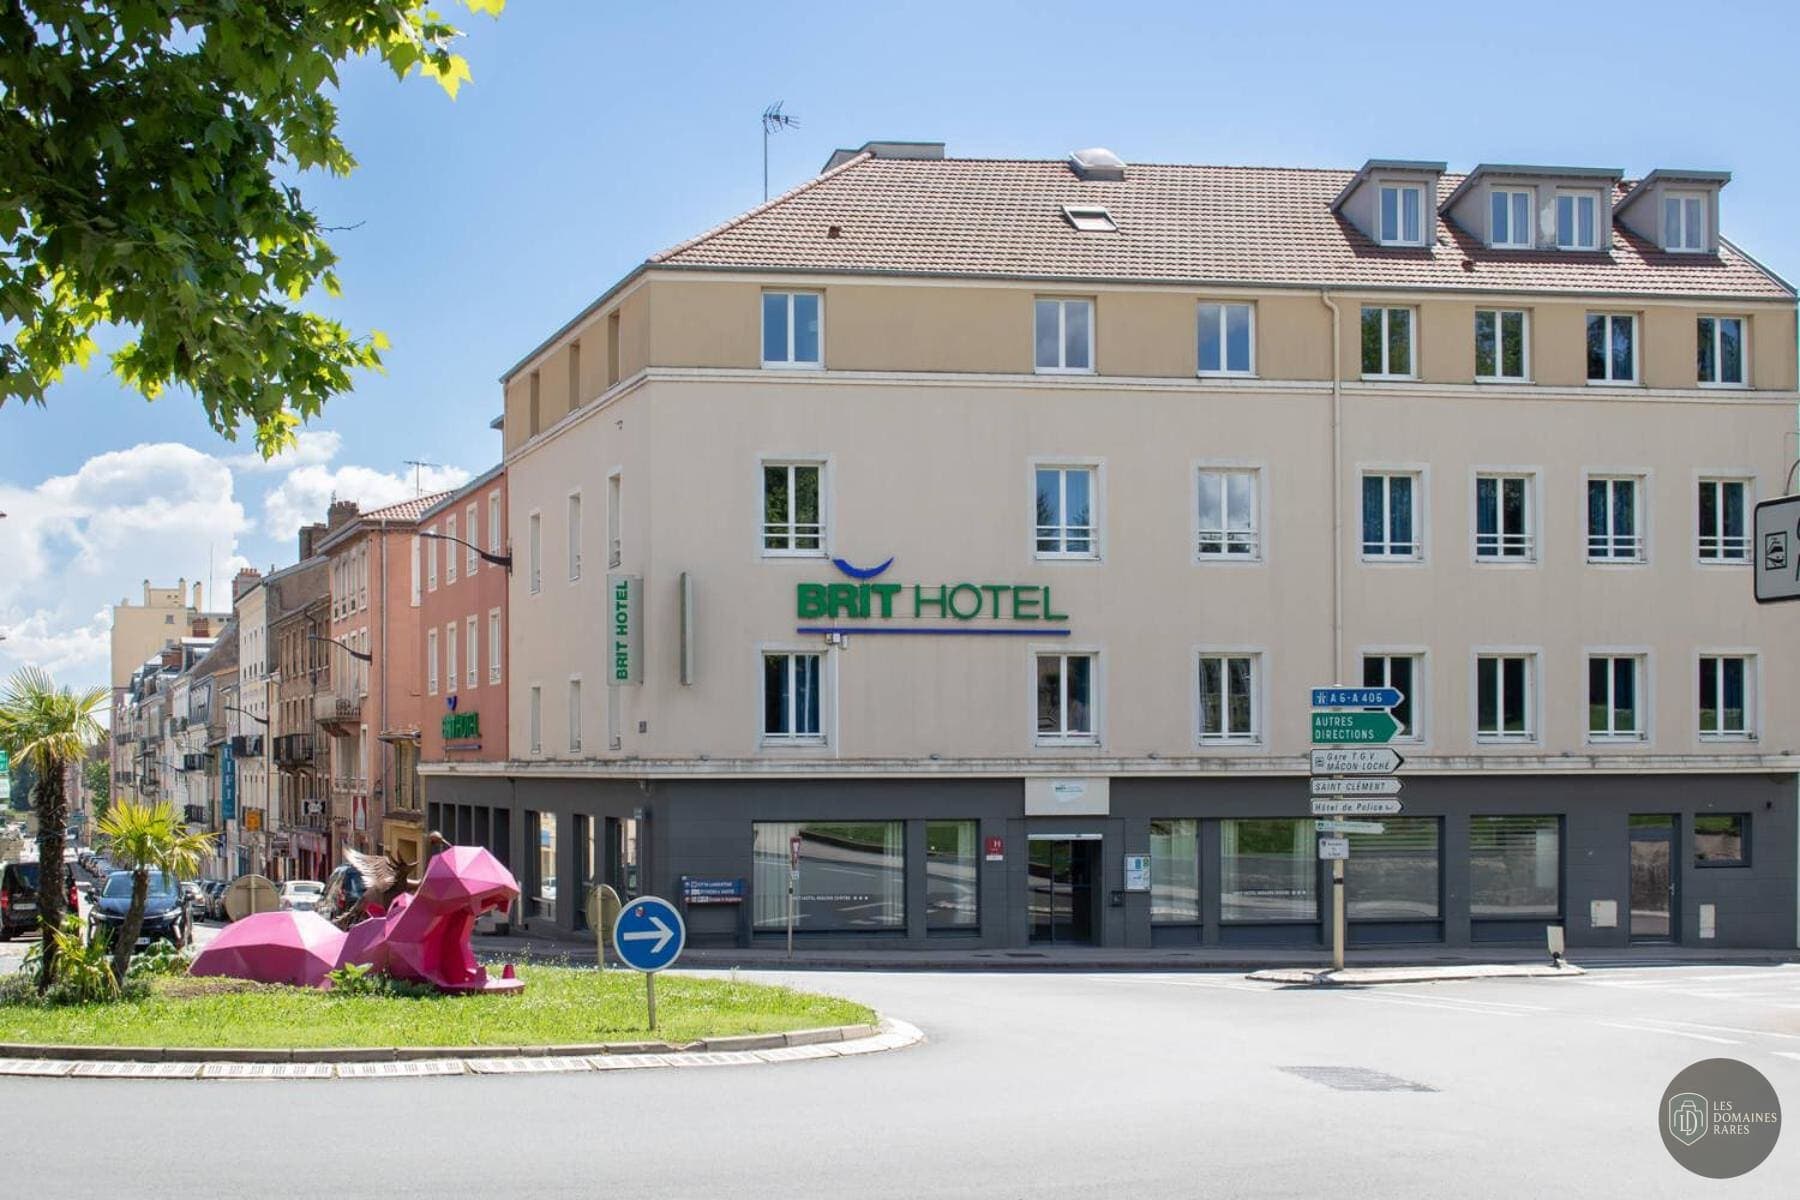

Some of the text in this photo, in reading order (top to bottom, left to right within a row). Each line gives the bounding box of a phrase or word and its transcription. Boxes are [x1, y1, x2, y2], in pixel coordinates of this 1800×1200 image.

[797, 583, 1069, 620] BRIT HOTEL
[616, 580, 628, 680] BRIT HOTEL
[1315, 716, 1353, 726] AUTRES
[1315, 729, 1375, 739] DIRECTIONS
[1327, 752, 1347, 760] Gare
[1314, 783, 1341, 791] SAINT
[1343, 802, 1352, 811] de
[1357, 801, 1383, 811] Police
